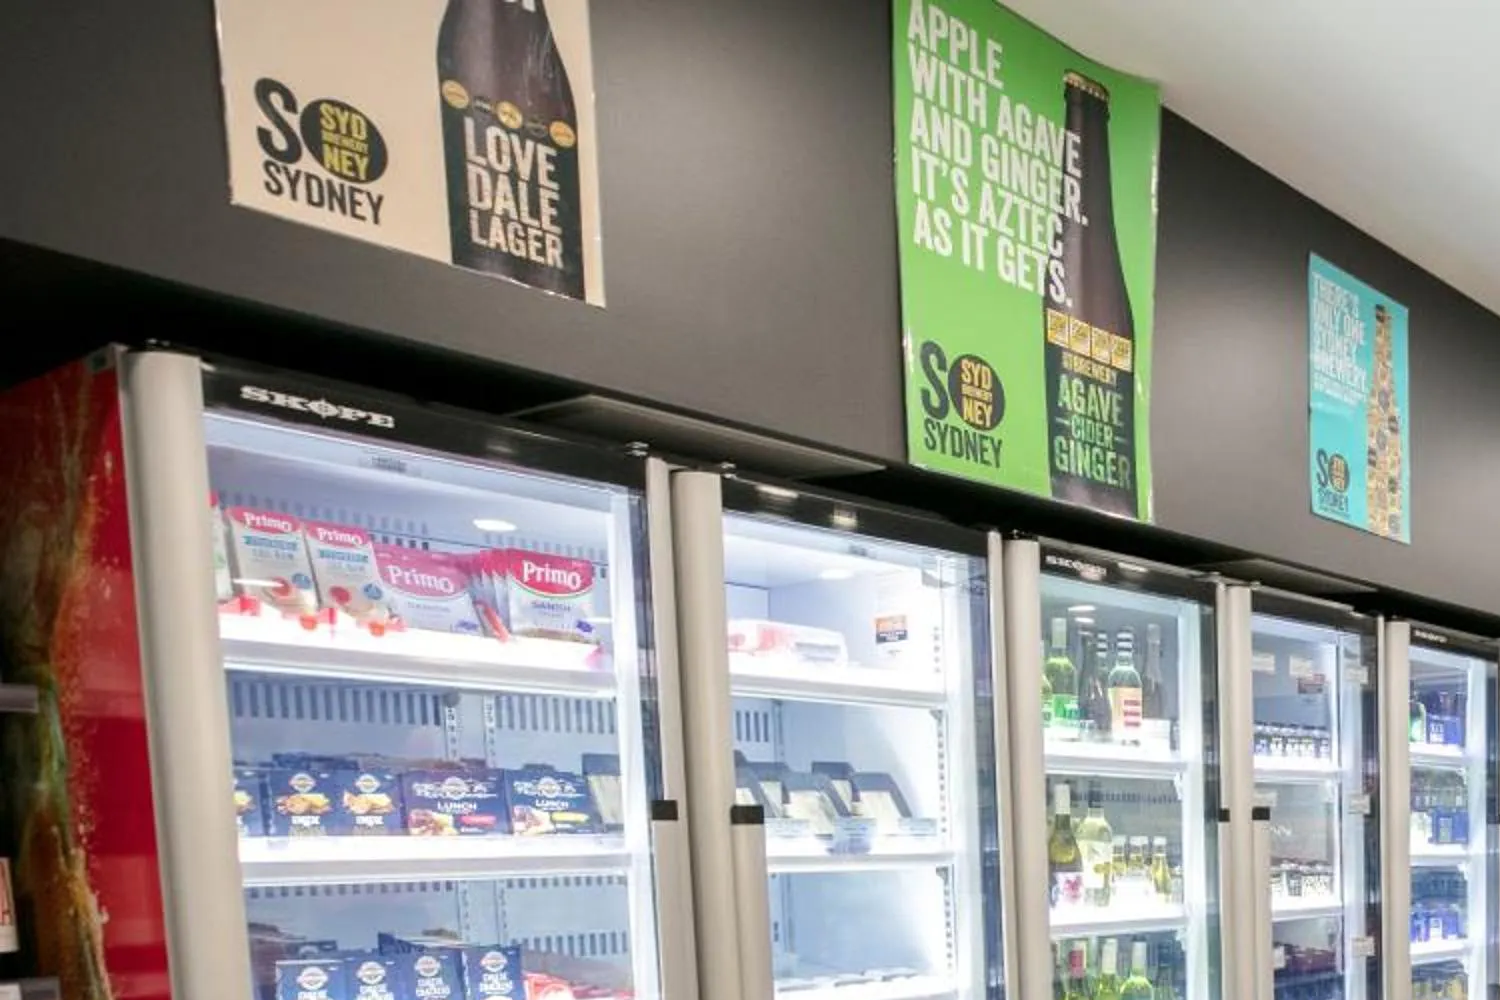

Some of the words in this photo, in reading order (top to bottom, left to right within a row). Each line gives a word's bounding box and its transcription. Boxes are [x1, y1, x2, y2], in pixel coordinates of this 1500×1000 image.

[907, 0, 1003, 90] APPLE
[320, 102, 368, 141] SYD
[907, 44, 987, 126] WITH
[997, 106, 1082, 179] AGAVE
[323, 143, 369, 181] NEY
[463, 116, 558, 190] LOVE
[911, 103, 971, 168] AND
[981, 131, 1089, 227] GINGER.
[263, 159, 384, 226] SYDNEY
[467, 166, 563, 237] DALE
[911, 151, 969, 215] IT'S
[977, 180, 1064, 258] AZTEC
[470, 208, 564, 269] LAGER
[913, 199, 953, 258] AS
[961, 220, 988, 273] IT
[998, 234, 1072, 308] GETS.
[961, 358, 993, 391] SYD
[1058, 373, 1124, 427] AGAVE
[240, 385, 396, 430] SKOPE
[963, 396, 993, 428] NEY
[1070, 413, 1114, 449] CIDER
[924, 417, 1003, 469] SYDNEY
[1054, 435, 1131, 490] GINGER
[243, 511, 293, 532] Primo
[317, 527, 363, 546] Primo
[386, 564, 455, 594] Primo
[522, 559, 582, 591] Primo
